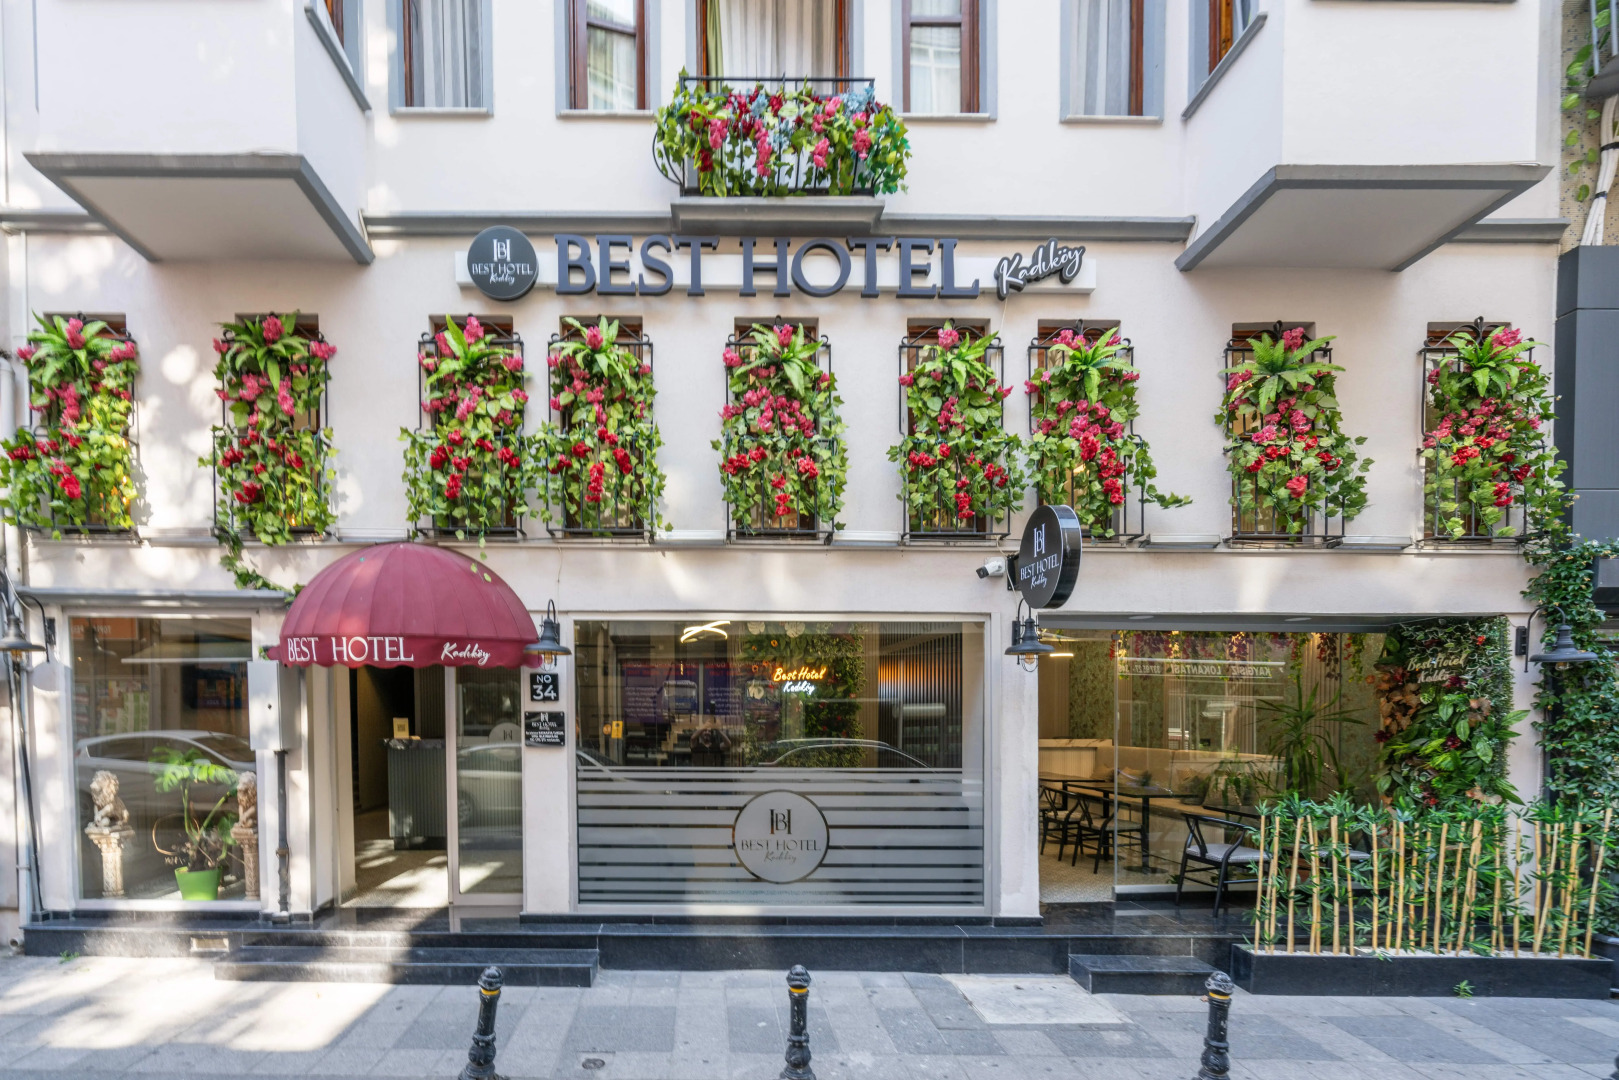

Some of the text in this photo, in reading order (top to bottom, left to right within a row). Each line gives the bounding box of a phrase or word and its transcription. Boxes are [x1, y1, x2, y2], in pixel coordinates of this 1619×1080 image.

[472, 263, 533, 275] BEST HOTEL
[554, 234, 720, 296] BEST
[739, 235, 979, 299] HOTEL
[1020, 553, 1059, 581] BEST HOTEL
[287, 636, 319, 662] BEST
[331, 636, 414, 662] HOTEL
[1407, 648, 1470, 671] Best Hotel
[536, 674, 552, 684] NO
[773, 666, 827, 682] Best Hotel
[532, 684, 557, 700] 34
[741, 839, 821, 851] BEST HOTEL
